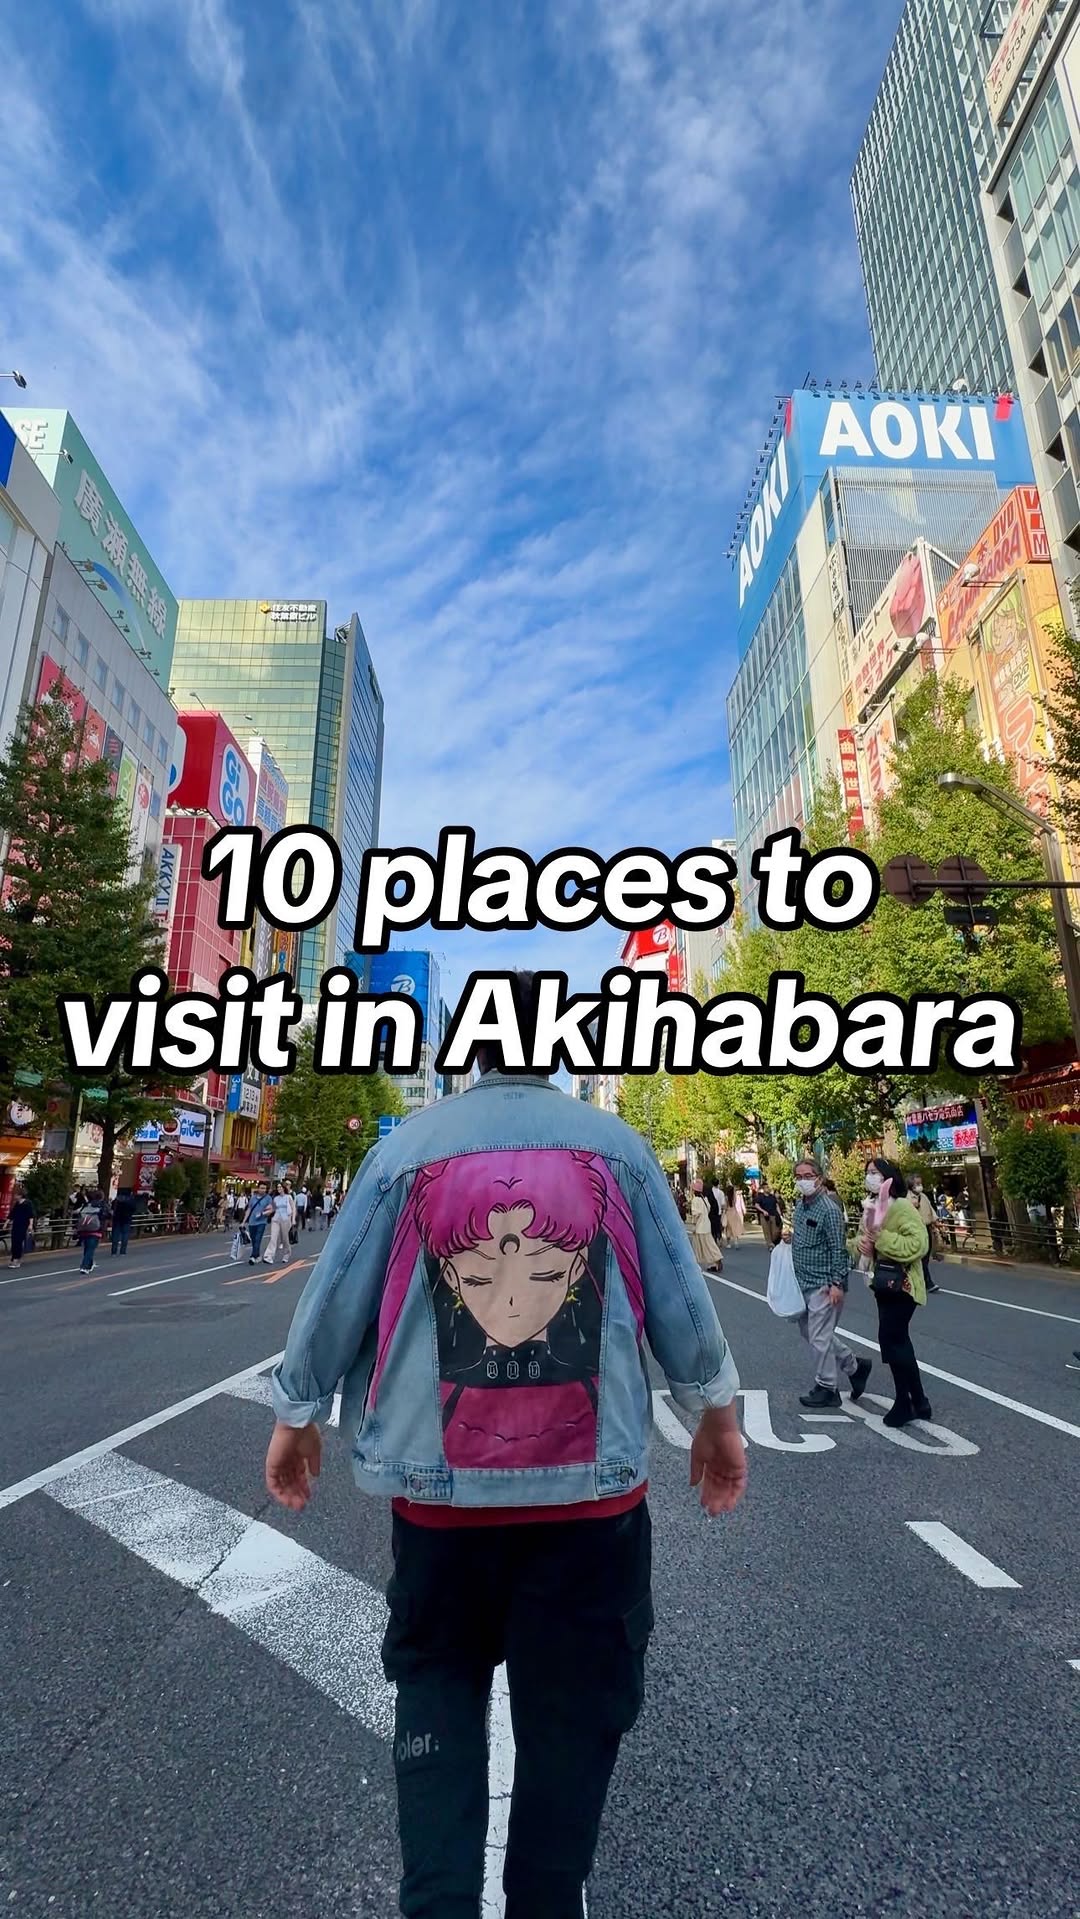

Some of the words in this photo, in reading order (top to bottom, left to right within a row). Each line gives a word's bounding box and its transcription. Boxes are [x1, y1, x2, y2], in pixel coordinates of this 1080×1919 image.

[819, 402, 995, 460] AOKI
[739, 437, 789, 608] AOKI
[994, 500, 1014, 545] DVD
[158, 847, 175, 895] AKKY
